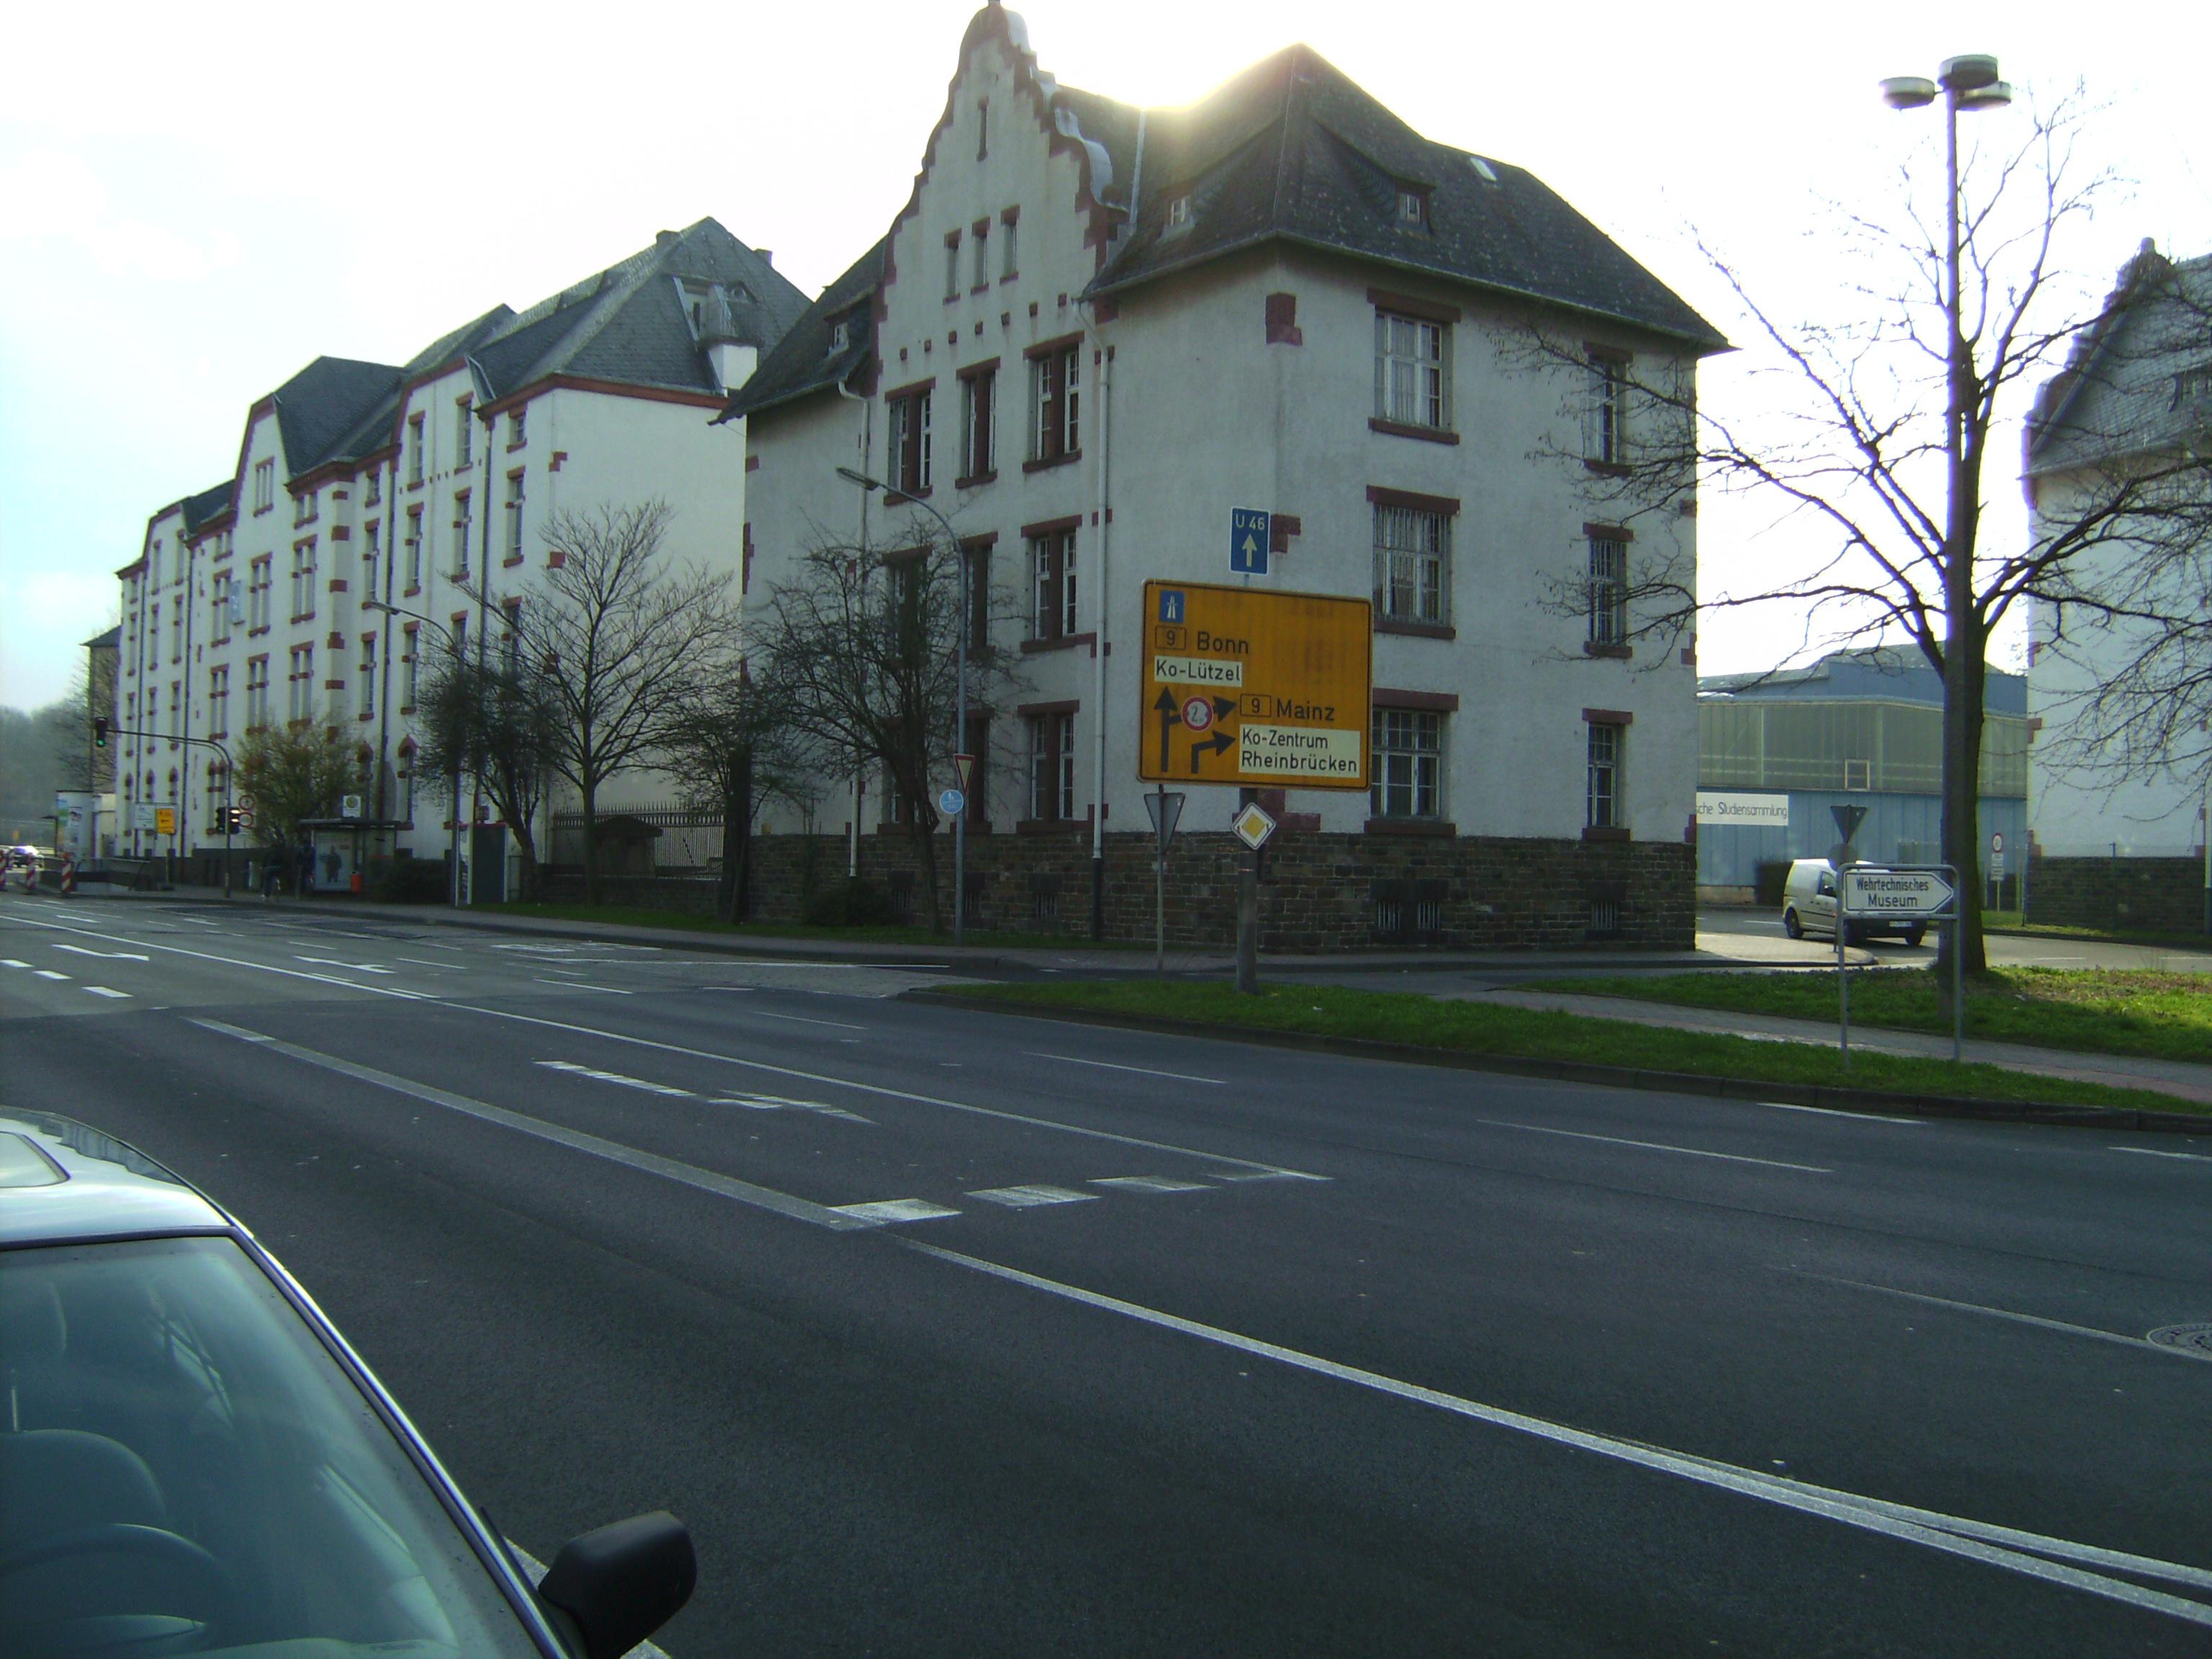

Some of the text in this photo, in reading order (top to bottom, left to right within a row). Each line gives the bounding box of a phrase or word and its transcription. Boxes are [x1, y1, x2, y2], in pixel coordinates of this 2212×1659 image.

[1236, 513, 1265, 531] U 46
[1166, 630, 1249, 654] 9 Bonn
[1156, 659, 1240, 681] Ko-Lützel
[1251, 697, 1335, 721] 9 Mainz
[1242, 728, 1328, 749] Ko-Zentrum
[1241, 750, 1357, 773] Rheinbrücken
[1718, 801, 1787, 819] Studiensammlung
[1856, 877, 1929, 891] Wehrtechnisches
[1868, 893, 1917, 907] Museum
